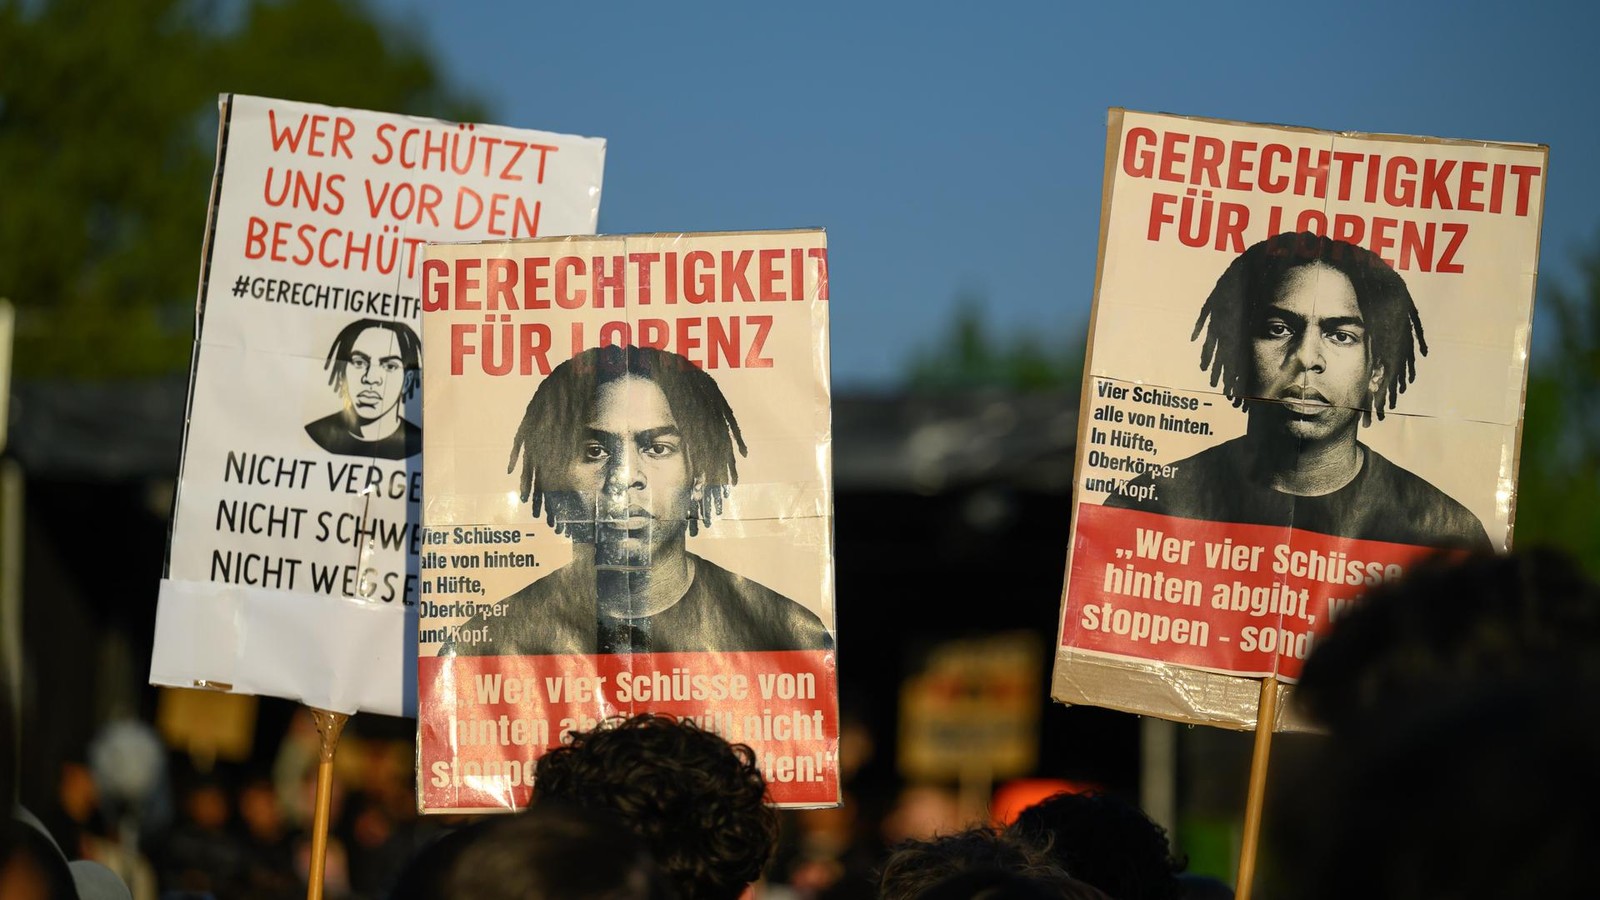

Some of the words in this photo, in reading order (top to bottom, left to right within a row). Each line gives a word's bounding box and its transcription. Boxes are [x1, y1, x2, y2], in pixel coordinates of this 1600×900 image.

[268, 110, 355, 159] WER
[371, 123, 559, 185] SCHÜTZT
[1122, 127, 1541, 217] GERECHTIGKEIT
[264, 167, 346, 216] UNS
[364, 179, 443, 228] VOR
[453, 186, 542, 238] DEN
[1147, 188, 1250, 254] FÜR
[422, 247, 829, 312] GERECHTIGKEIT
[450, 314, 552, 376] FÜR
[1098, 380, 1129, 400] Vier
[1132, 386, 1199, 411] Schüsse
[1093, 405, 1124, 423] alle
[1128, 411, 1156, 428] von
[1159, 413, 1214, 436] hinten.
[1090, 427, 1106, 445] In
[1110, 429, 1158, 456] Hüfte,
[224, 450, 317, 490] NICHT
[327, 461, 421, 503] VERGE
[1088, 450, 1179, 480] Oberkörper
[1085, 477, 1115, 494] und
[1118, 479, 1159, 502] Kopf.
[216, 499, 308, 539] NICHT
[453, 527, 521, 544] Schüsse
[451, 555, 480, 568] von
[484, 551, 540, 568] hinten.
[1115, 527, 1195, 565] „Wer
[1204, 537, 1265, 572] vier
[1272, 544, 1403, 586] Schüsse
[210, 549, 302, 590] NICHT
[311, 562, 418, 606] WEGSE
[437, 576, 485, 596] Hüfte,
[1103, 562, 1203, 607] hinten
[1211, 581, 1316, 625] abgibt,
[420, 601, 509, 621] Oberkörper
[1081, 602, 1210, 648] stoppen
[419, 626, 447, 643] und
[451, 625, 493, 647] Kopf.
[545, 672, 607, 704] vier
[615, 668, 748, 703] Schüsse
[758, 672, 816, 700] von
[448, 713, 549, 747] hinten
[743, 708, 825, 741] nicht
